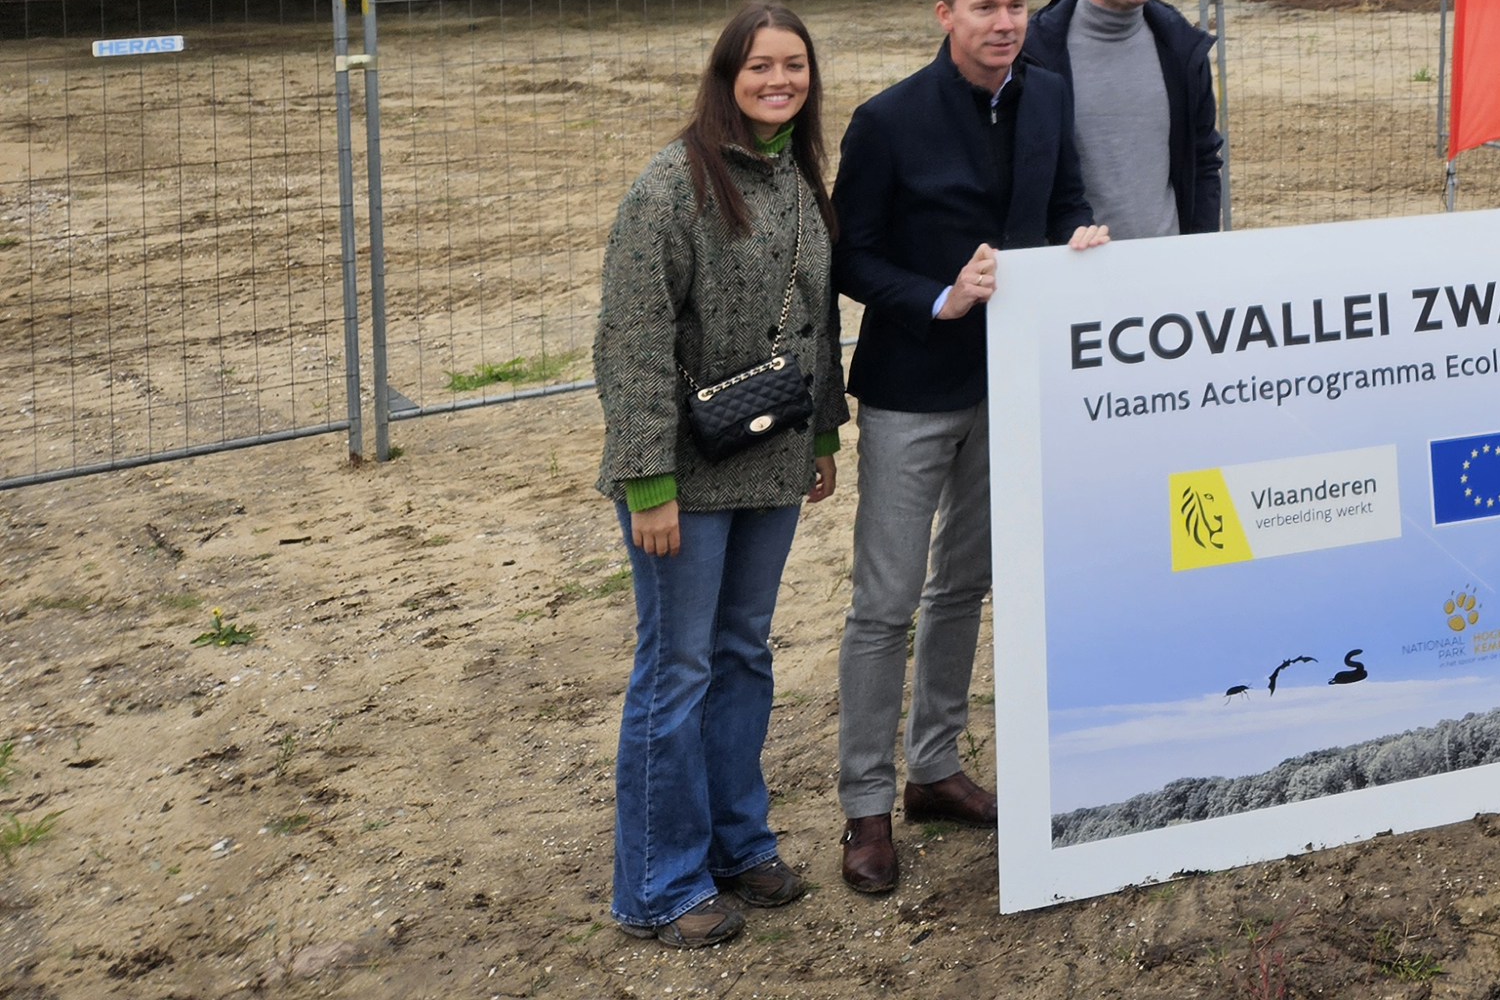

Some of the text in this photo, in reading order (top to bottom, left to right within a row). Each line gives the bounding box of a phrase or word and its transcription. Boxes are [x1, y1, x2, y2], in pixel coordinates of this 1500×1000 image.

[98, 37, 175, 55] HERAS
[1070, 292, 1390, 370] ECOVALLEI
[1083, 389, 1191, 421] Vlaams
[1200, 360, 1437, 408] Actieprogramma
[1251, 478, 1377, 510] Vlaanderen
[1256, 501, 1374, 530] verbeelding werkt
[1402, 636, 1465, 655] NATIONAAL
[1438, 646, 1466, 660] PARK
